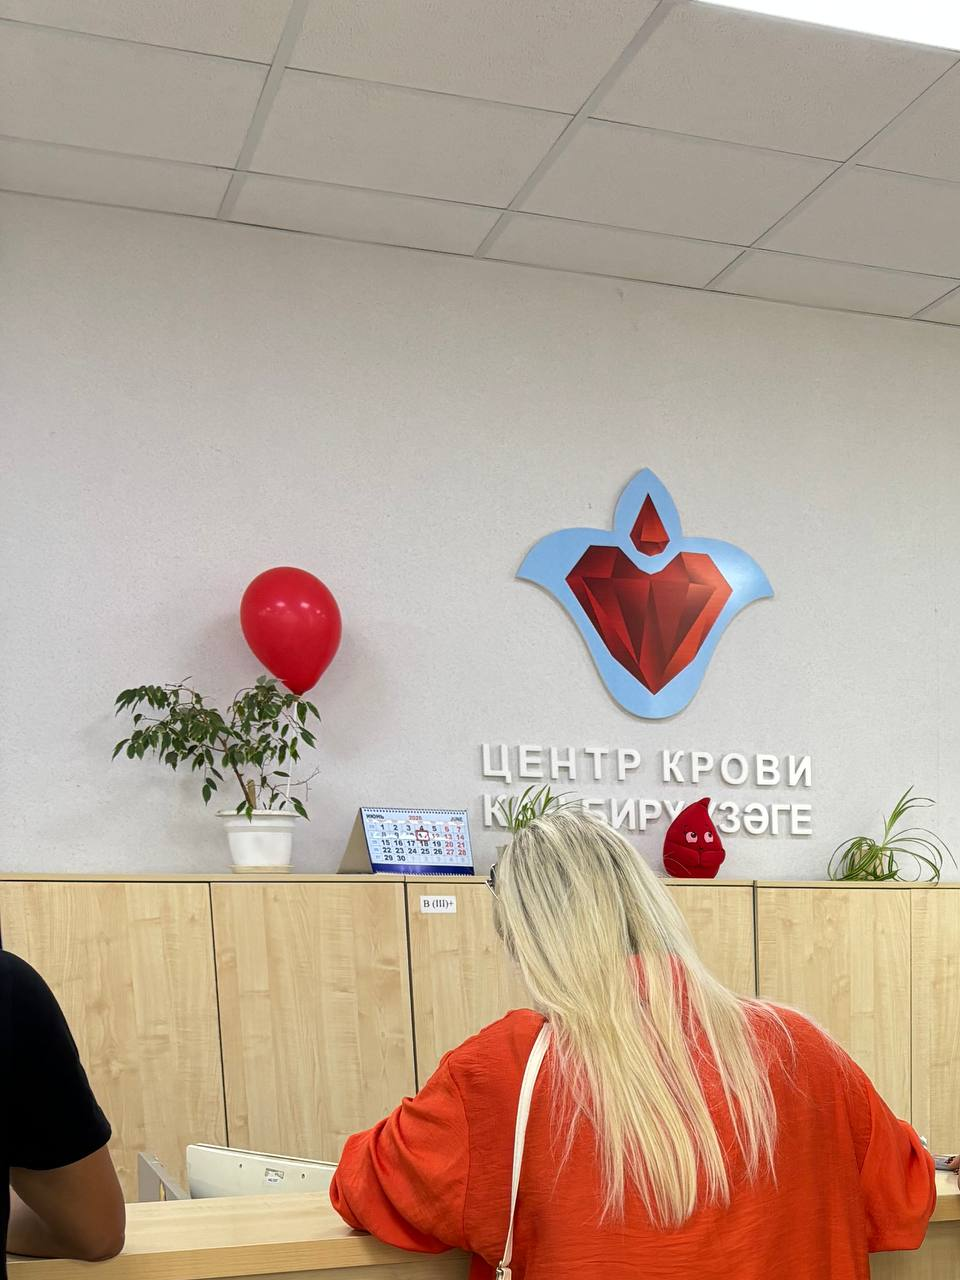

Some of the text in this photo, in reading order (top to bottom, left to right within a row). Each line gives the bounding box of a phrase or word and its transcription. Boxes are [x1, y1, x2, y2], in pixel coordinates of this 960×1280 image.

[481, 743, 813, 787] ЦЕНТР КРОВИ
[708, 800, 813, 835] ЗӘГЕ
[423, 899, 430, 908] B
